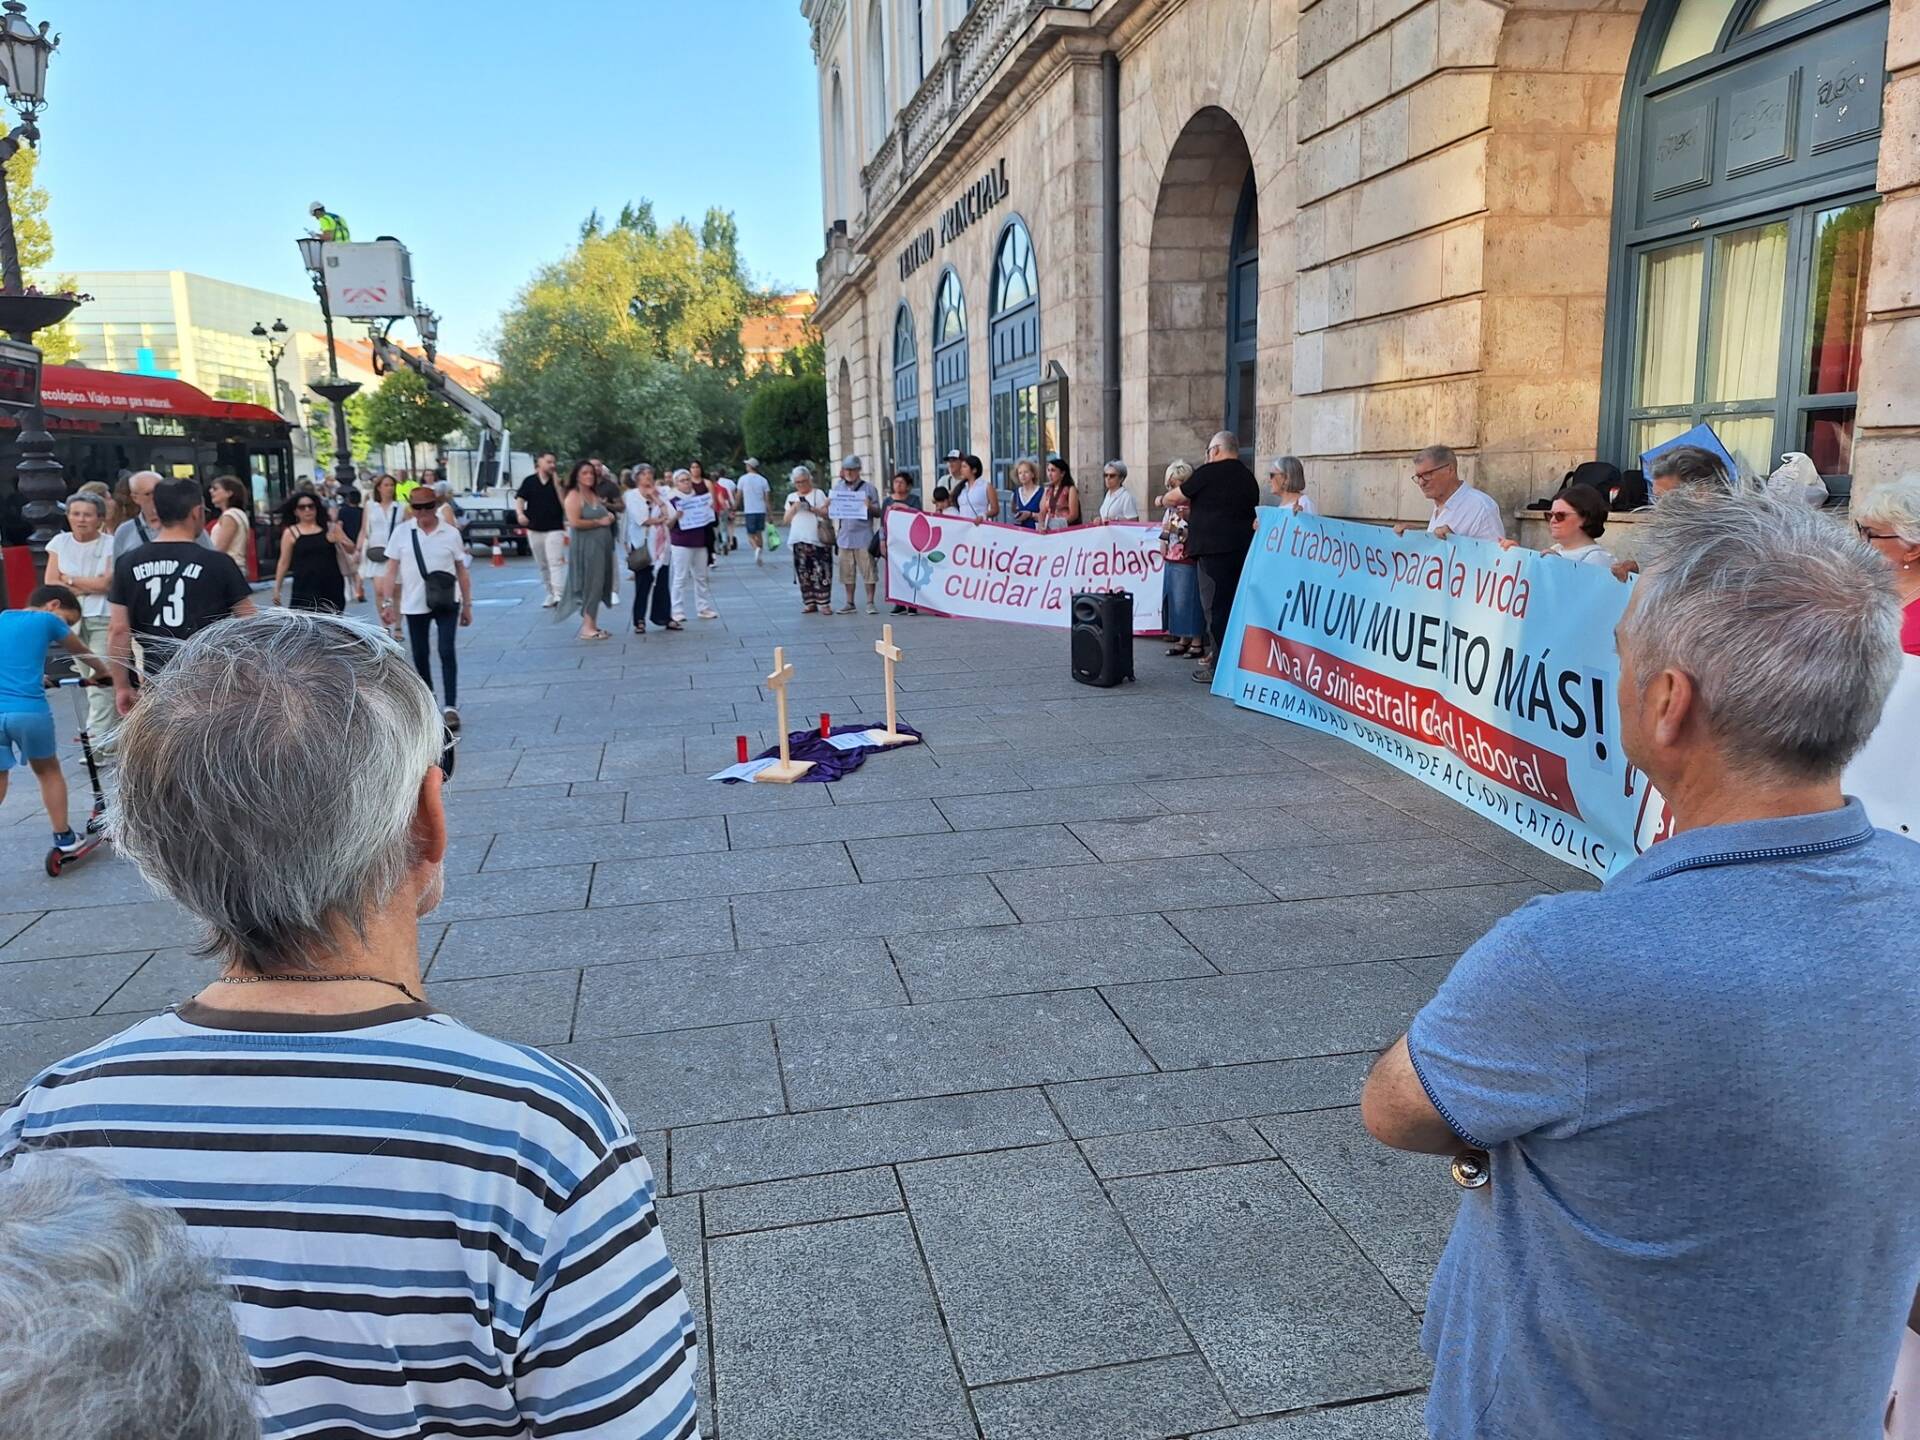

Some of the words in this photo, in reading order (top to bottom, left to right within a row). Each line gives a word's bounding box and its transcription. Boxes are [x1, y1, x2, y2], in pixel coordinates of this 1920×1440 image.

[938, 157, 1010, 249] PRINCIPAL
[145, 576, 185, 627] 13
[945, 572, 1039, 608] cuidar
[1040, 579, 1063, 610] la
[952, 542, 1048, 577] cuidar
[1051, 545, 1073, 578] el
[1075, 541, 1164, 582] trabajo
[1266, 517, 1288, 553] el
[1291, 523, 1360, 578] trabajo
[1366, 545, 1387, 577] es
[1390, 549, 1444, 592] para
[1447, 546, 1466, 598] la
[1475, 558, 1531, 619] vida
[1278, 580, 1322, 631] ¡NI
[1324, 587, 1366, 645] UN
[1494, 647, 1609, 761] MÁS!
[1242, 683, 1348, 731] HERMANDAD
[1353, 722, 1414, 764] OBRERA
[1416, 751, 1440, 776] DE
[1266, 638, 1291, 675] No
[1292, 657, 1302, 682] a
[1306, 653, 1323, 691] la
[1458, 716, 1559, 800] laboral.
